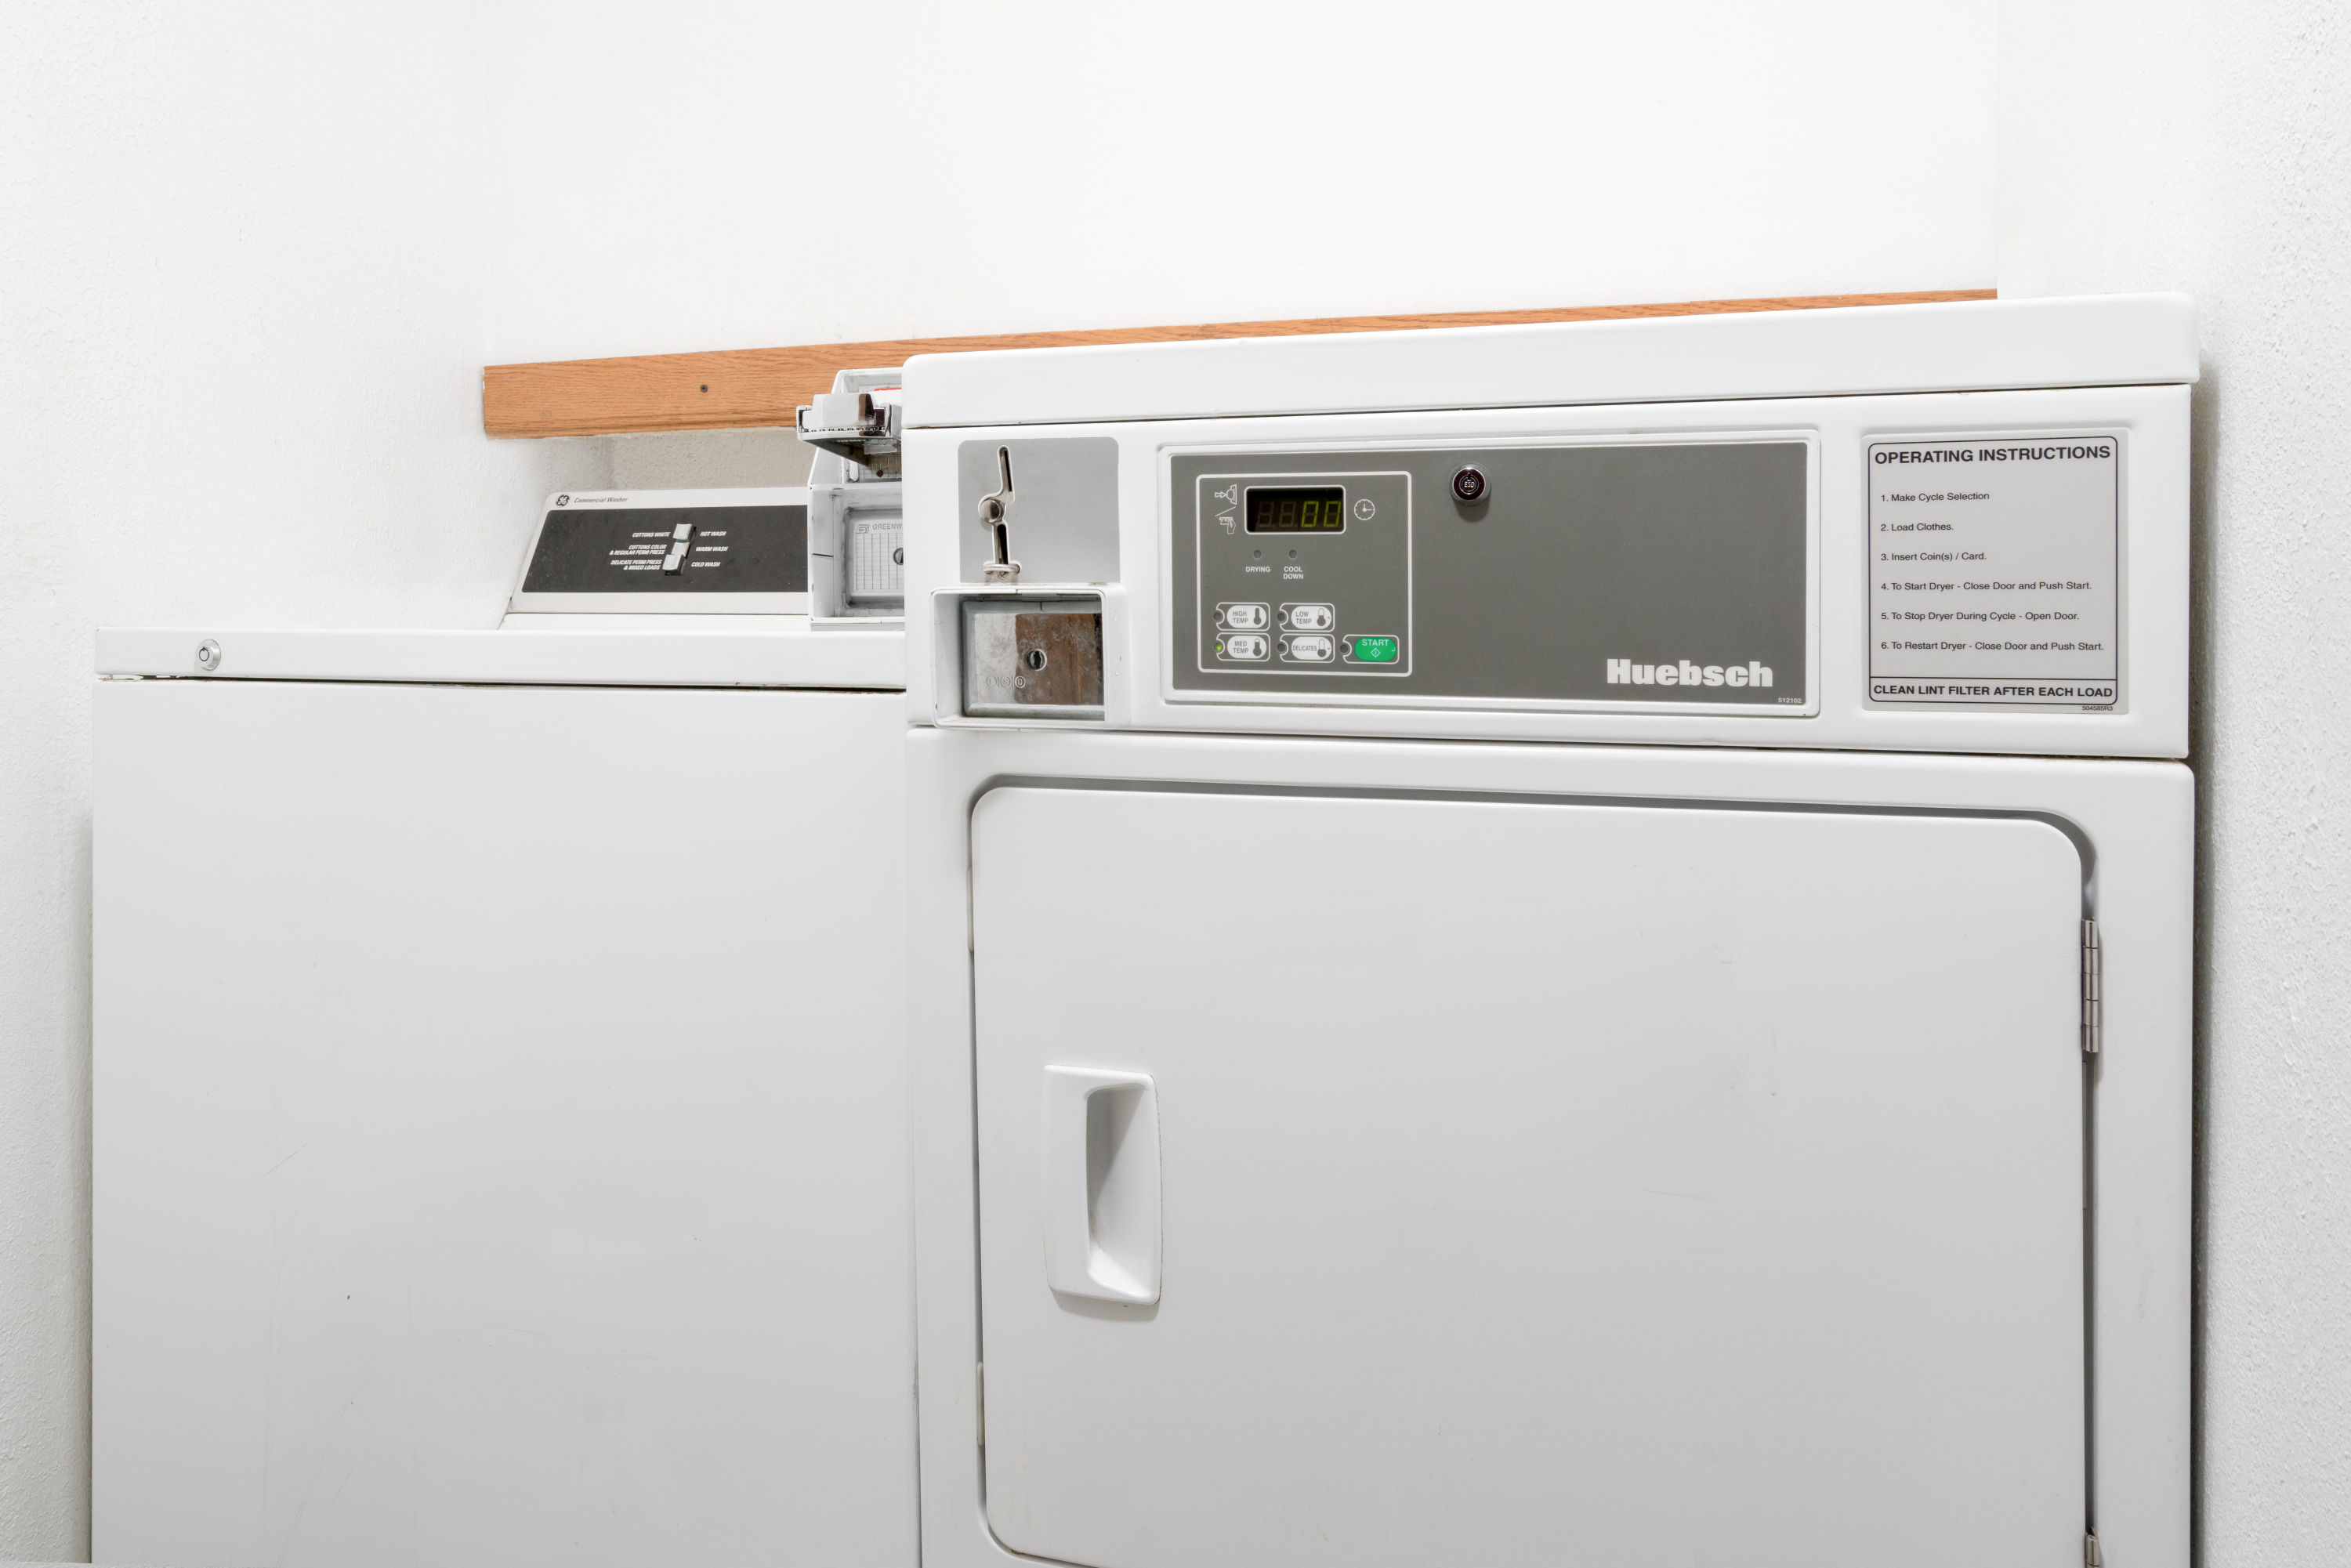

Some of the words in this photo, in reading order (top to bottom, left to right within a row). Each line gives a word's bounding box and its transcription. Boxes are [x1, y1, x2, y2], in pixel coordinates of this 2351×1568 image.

[1875, 449, 1973, 464] OPERATING
[1979, 446, 2110, 462] INSTRUCTIONS
[1918, 494, 1944, 502] Cycle
[1947, 492, 1990, 501] Selection
[1892, 552, 1918, 561] Insert
[1920, 552, 1953, 562] Coin(s)
[1929, 582, 1954, 592] Dryer
[1963, 581, 1990, 590] Close
[1993, 581, 2016, 590] Door
[2018, 581, 2036, 590] and
[1904, 612, 1925, 621] Stop
[1929, 612, 1954, 621] Dryer
[1957, 612, 1987, 621] During
[1989, 612, 2016, 621] Cycle
[2025, 612, 2051, 621] Open
[1940, 642, 1966, 651] Dryer
[2005, 642, 2027, 650] Door
[2030, 642, 2048, 650] and
[2051, 642, 2075, 650] Push
[1607, 659, 1773, 687] Huebsch
[1874, 685, 1914, 694] CLEAN
[1918, 686, 1945, 695] LINT
[1948, 686, 1991, 696] FILTER
[1994, 686, 2034, 696] AFTER
[2038, 686, 2074, 697] EACH
[2078, 687, 2113, 697] LOAD
